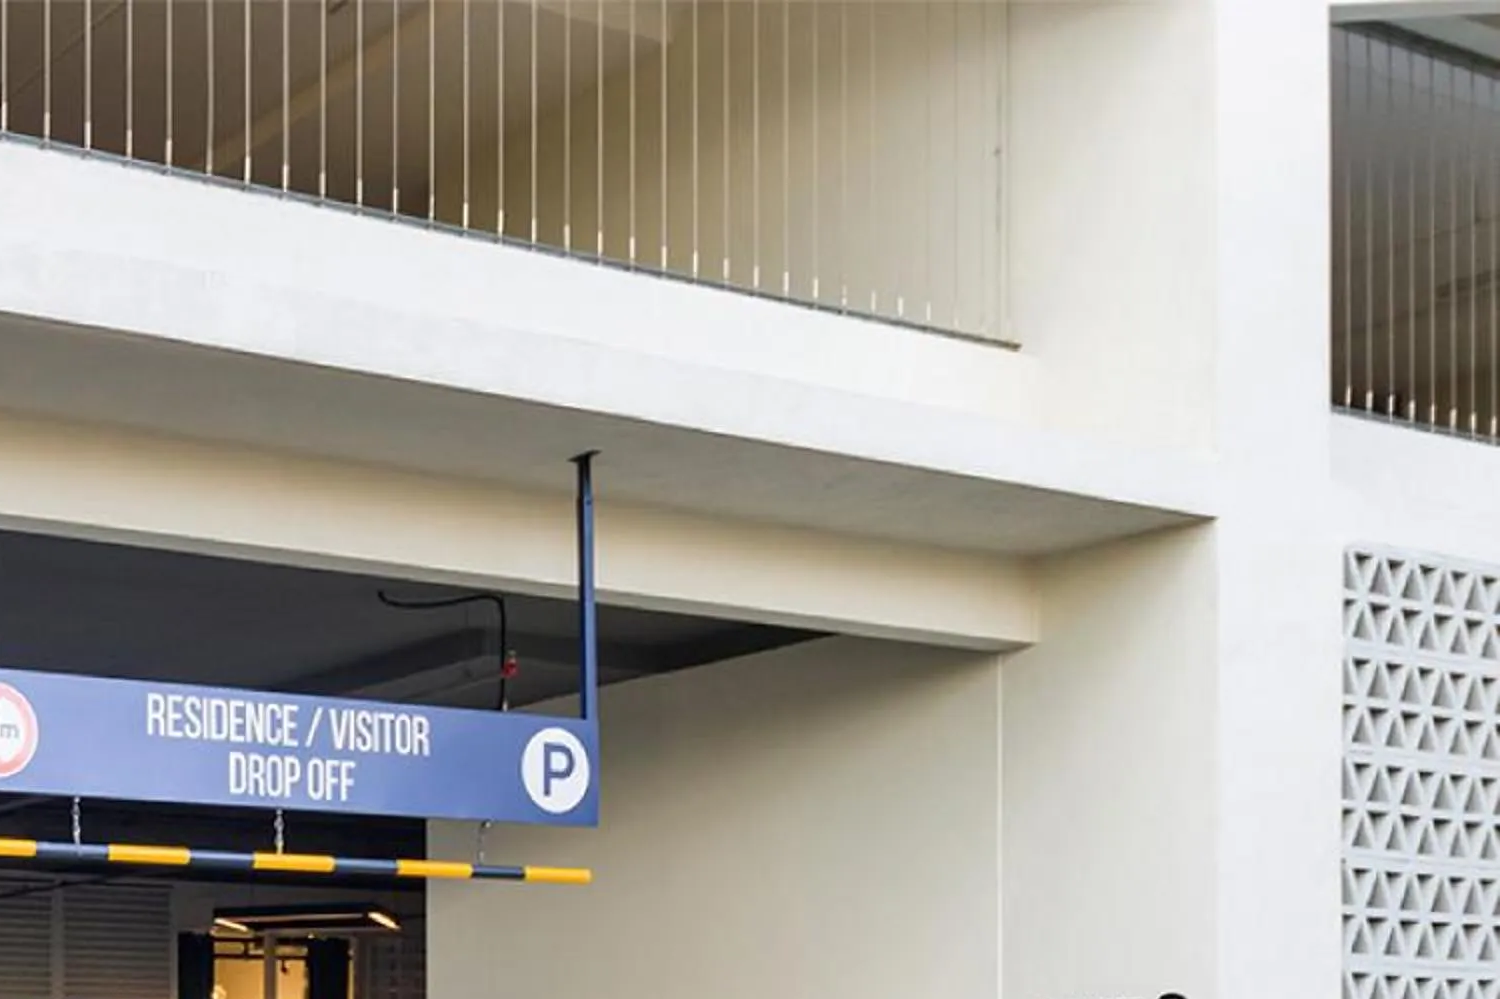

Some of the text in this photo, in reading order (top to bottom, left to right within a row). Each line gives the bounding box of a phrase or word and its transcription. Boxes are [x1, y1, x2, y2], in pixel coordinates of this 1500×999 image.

[147, 693, 299, 748] RESIDENCE
[329, 708, 431, 756] VISITOR
[228, 751, 356, 801] DROP OFF
[543, 742, 576, 797] P
